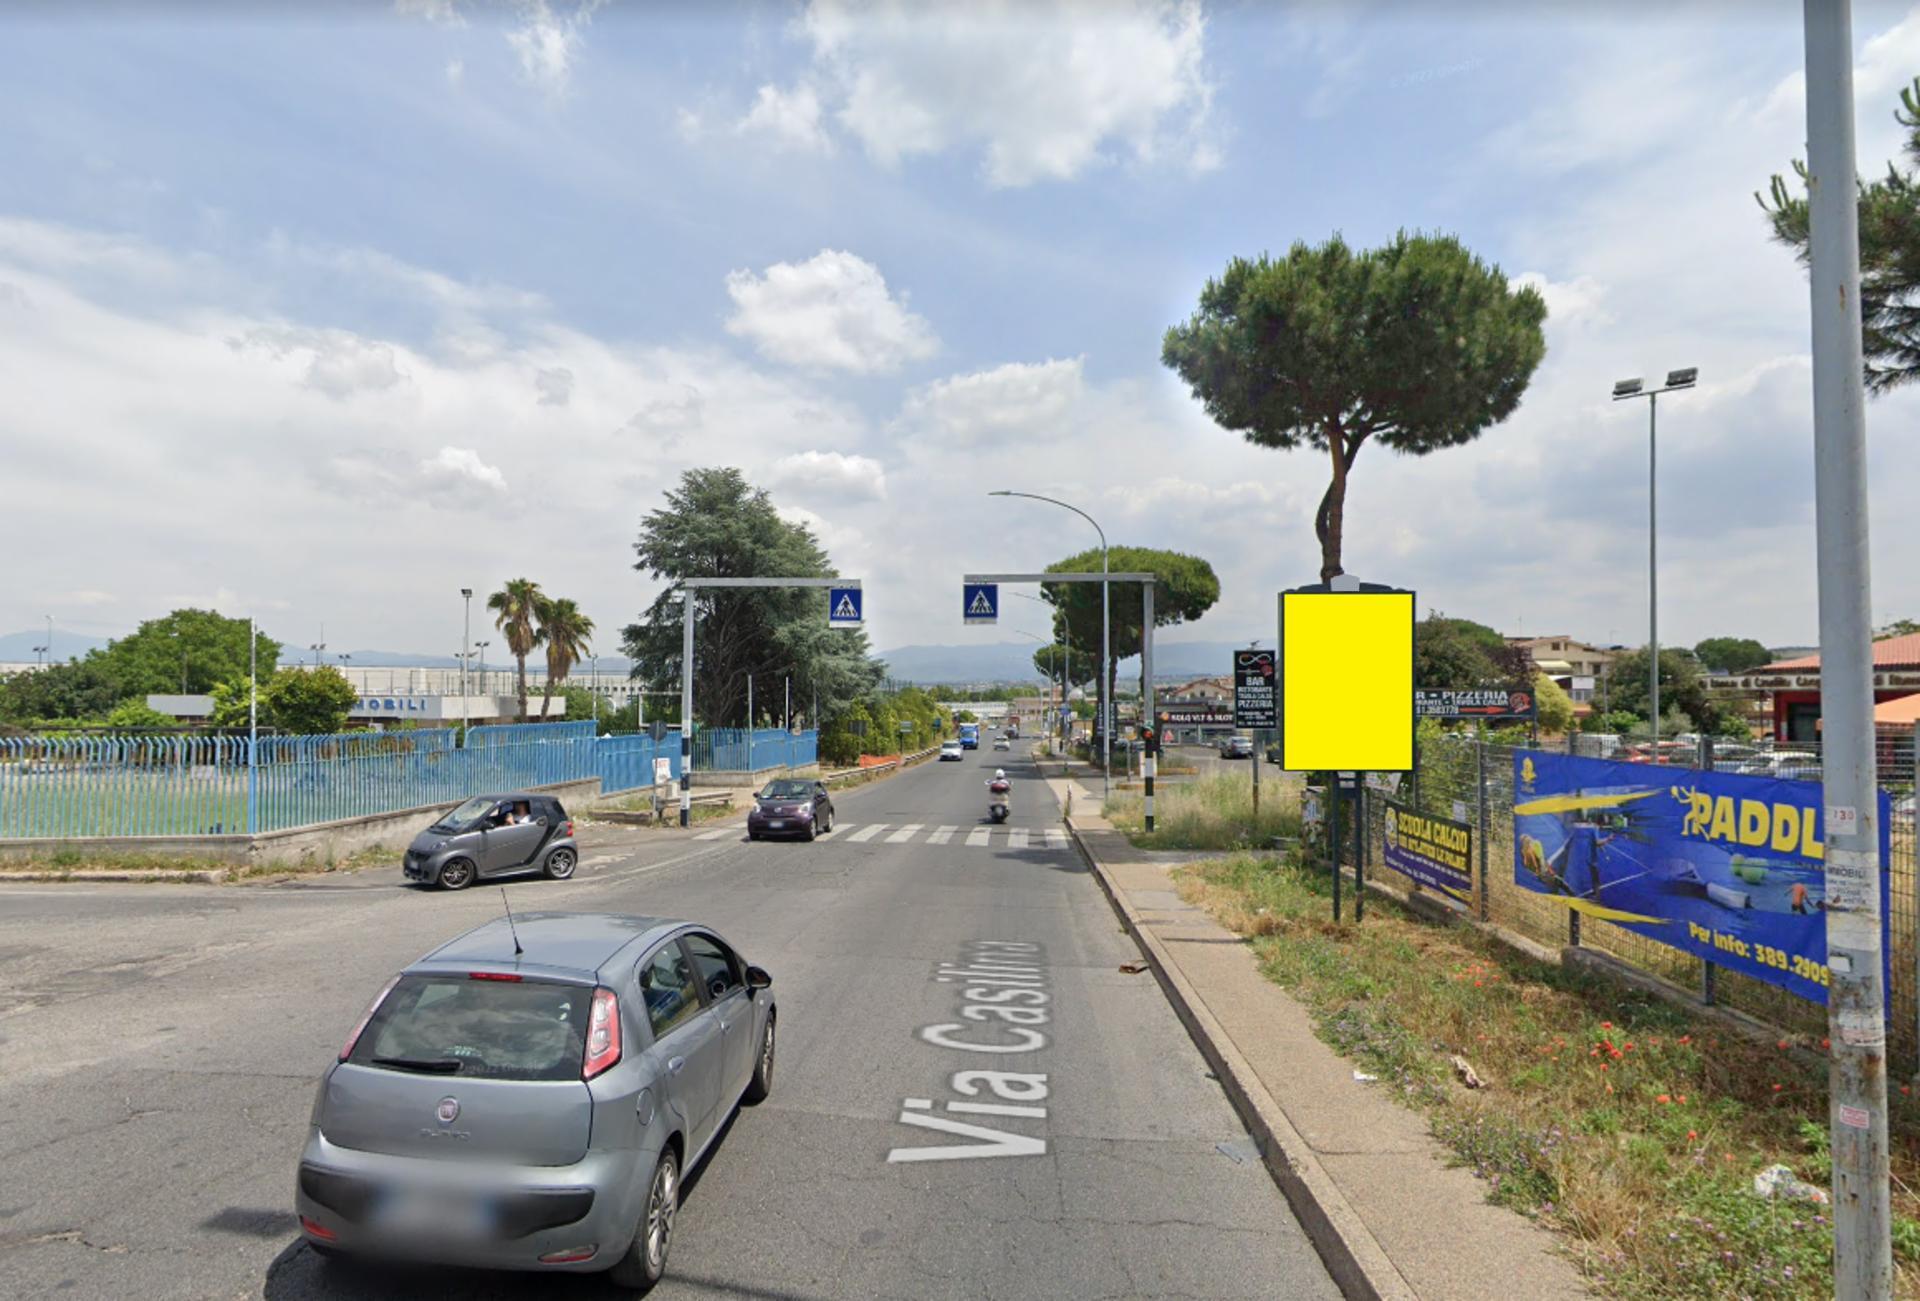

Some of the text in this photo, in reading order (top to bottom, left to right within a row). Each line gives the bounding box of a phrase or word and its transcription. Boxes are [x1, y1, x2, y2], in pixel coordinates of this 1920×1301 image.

[1246, 676, 1265, 686] BAR
[1442, 691, 1509, 700] PIZZERIA
[1237, 700, 1273, 709] PIZZERIA
[1398, 811, 1468, 854] SCUOLA CALCIO
[1689, 920, 1710, 944] Per
[1713, 929, 1750, 958] info:
